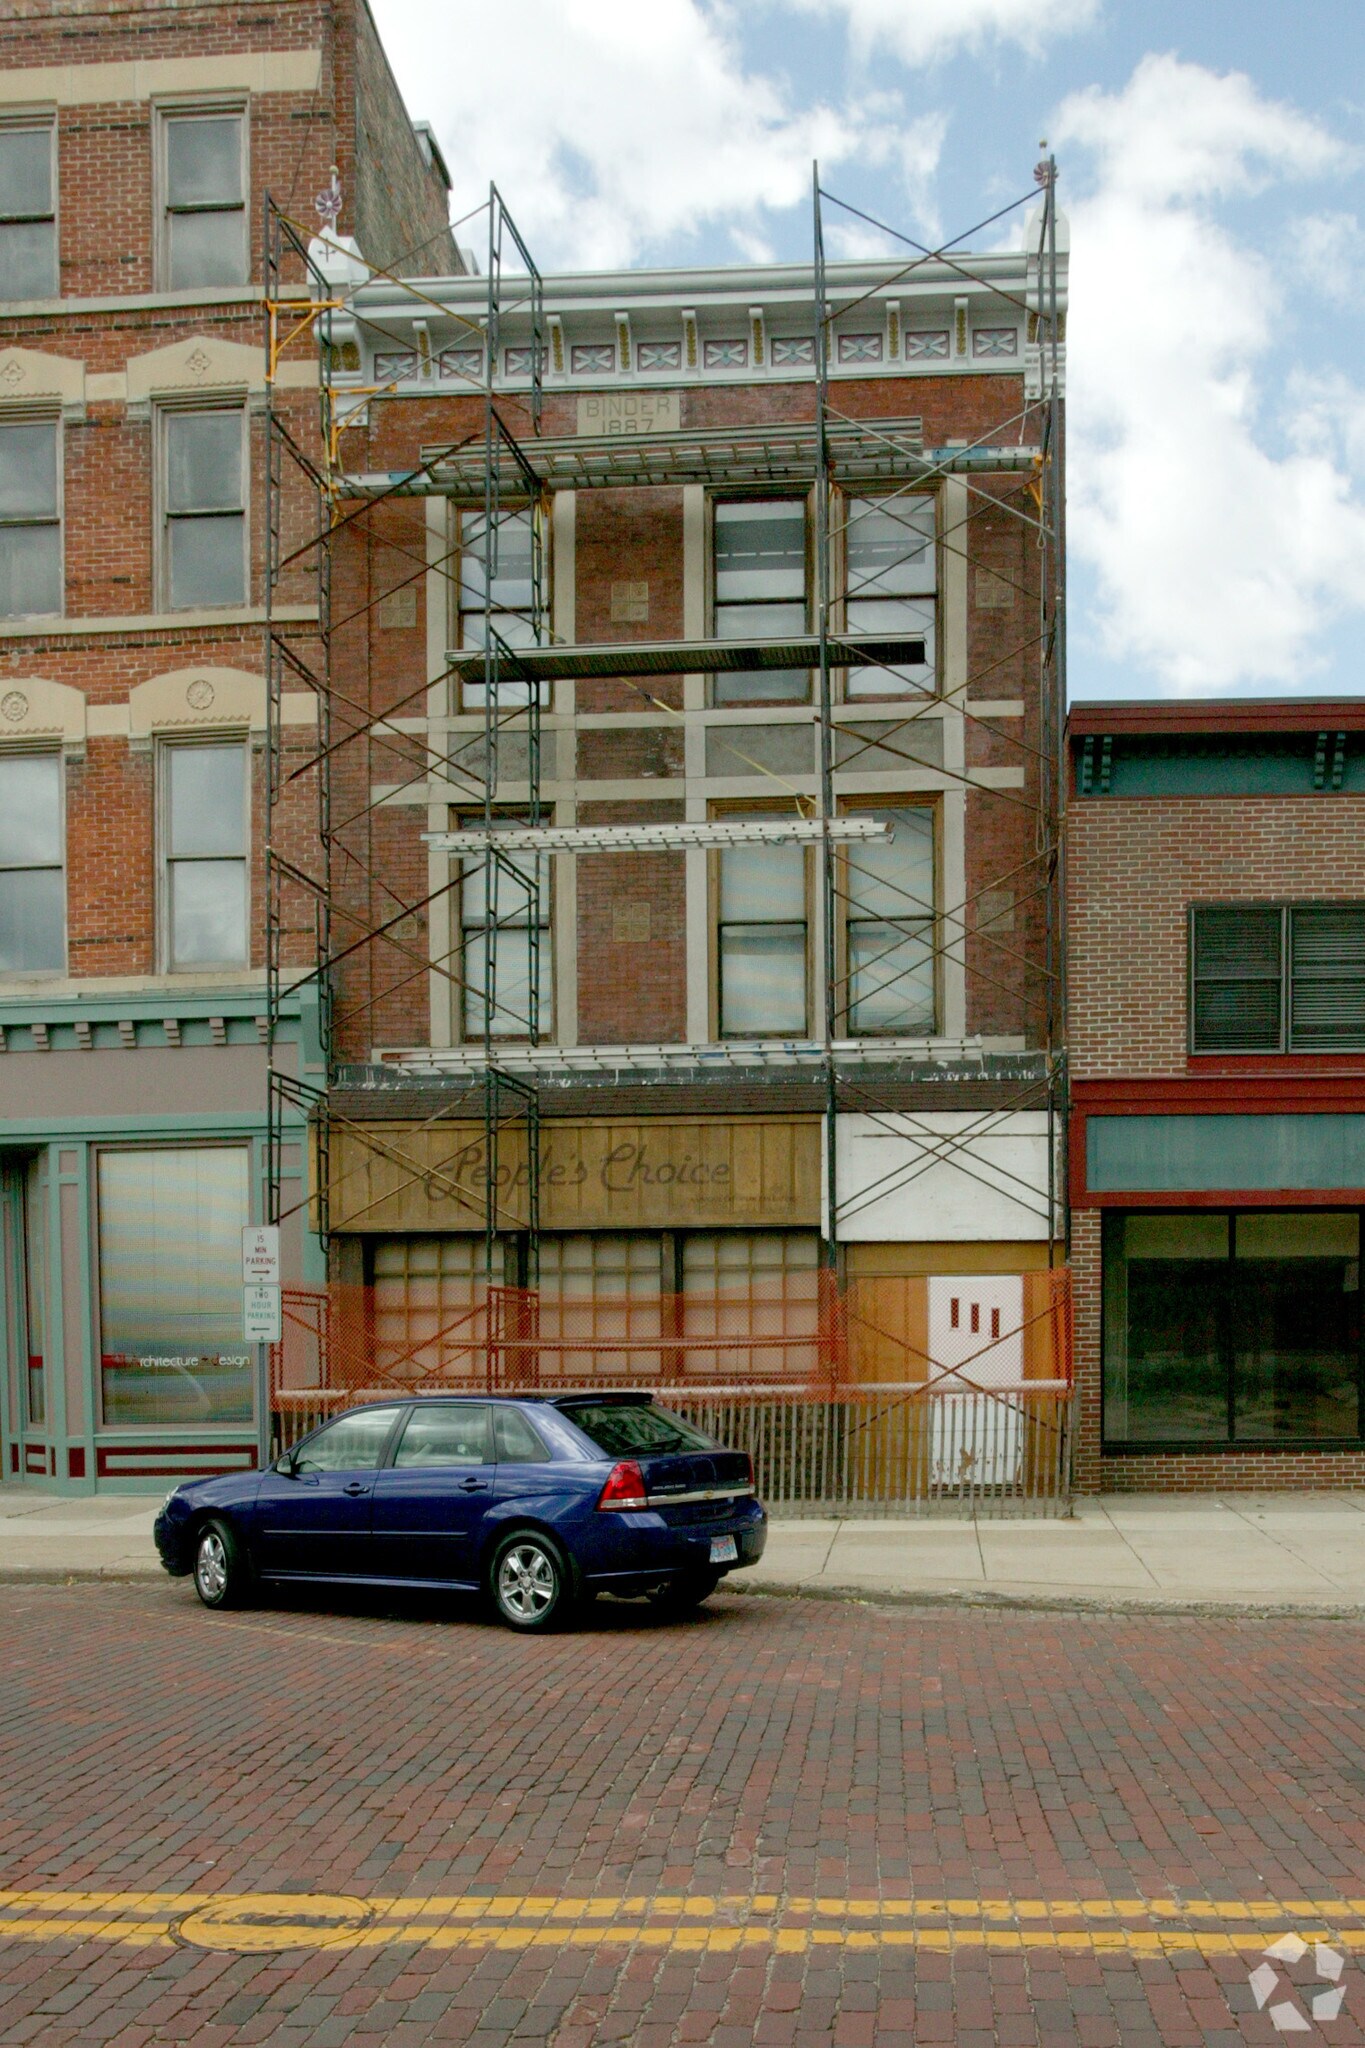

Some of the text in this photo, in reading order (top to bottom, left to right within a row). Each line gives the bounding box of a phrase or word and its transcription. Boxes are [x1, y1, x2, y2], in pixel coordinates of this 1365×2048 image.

[586, 396, 670, 418] BINDER
[602, 418, 654, 434] 1887
[424, 1142, 731, 1203] People's Choice
[257, 1235, 265, 1243] 15
[254, 1246, 267, 1254] MIN
[245, 1257, 276, 1265] PARKING
[254, 1291, 269, 1299] TWO
[251, 1301, 272, 1309] HOUR
[247, 1312, 276, 1320] PARKING
